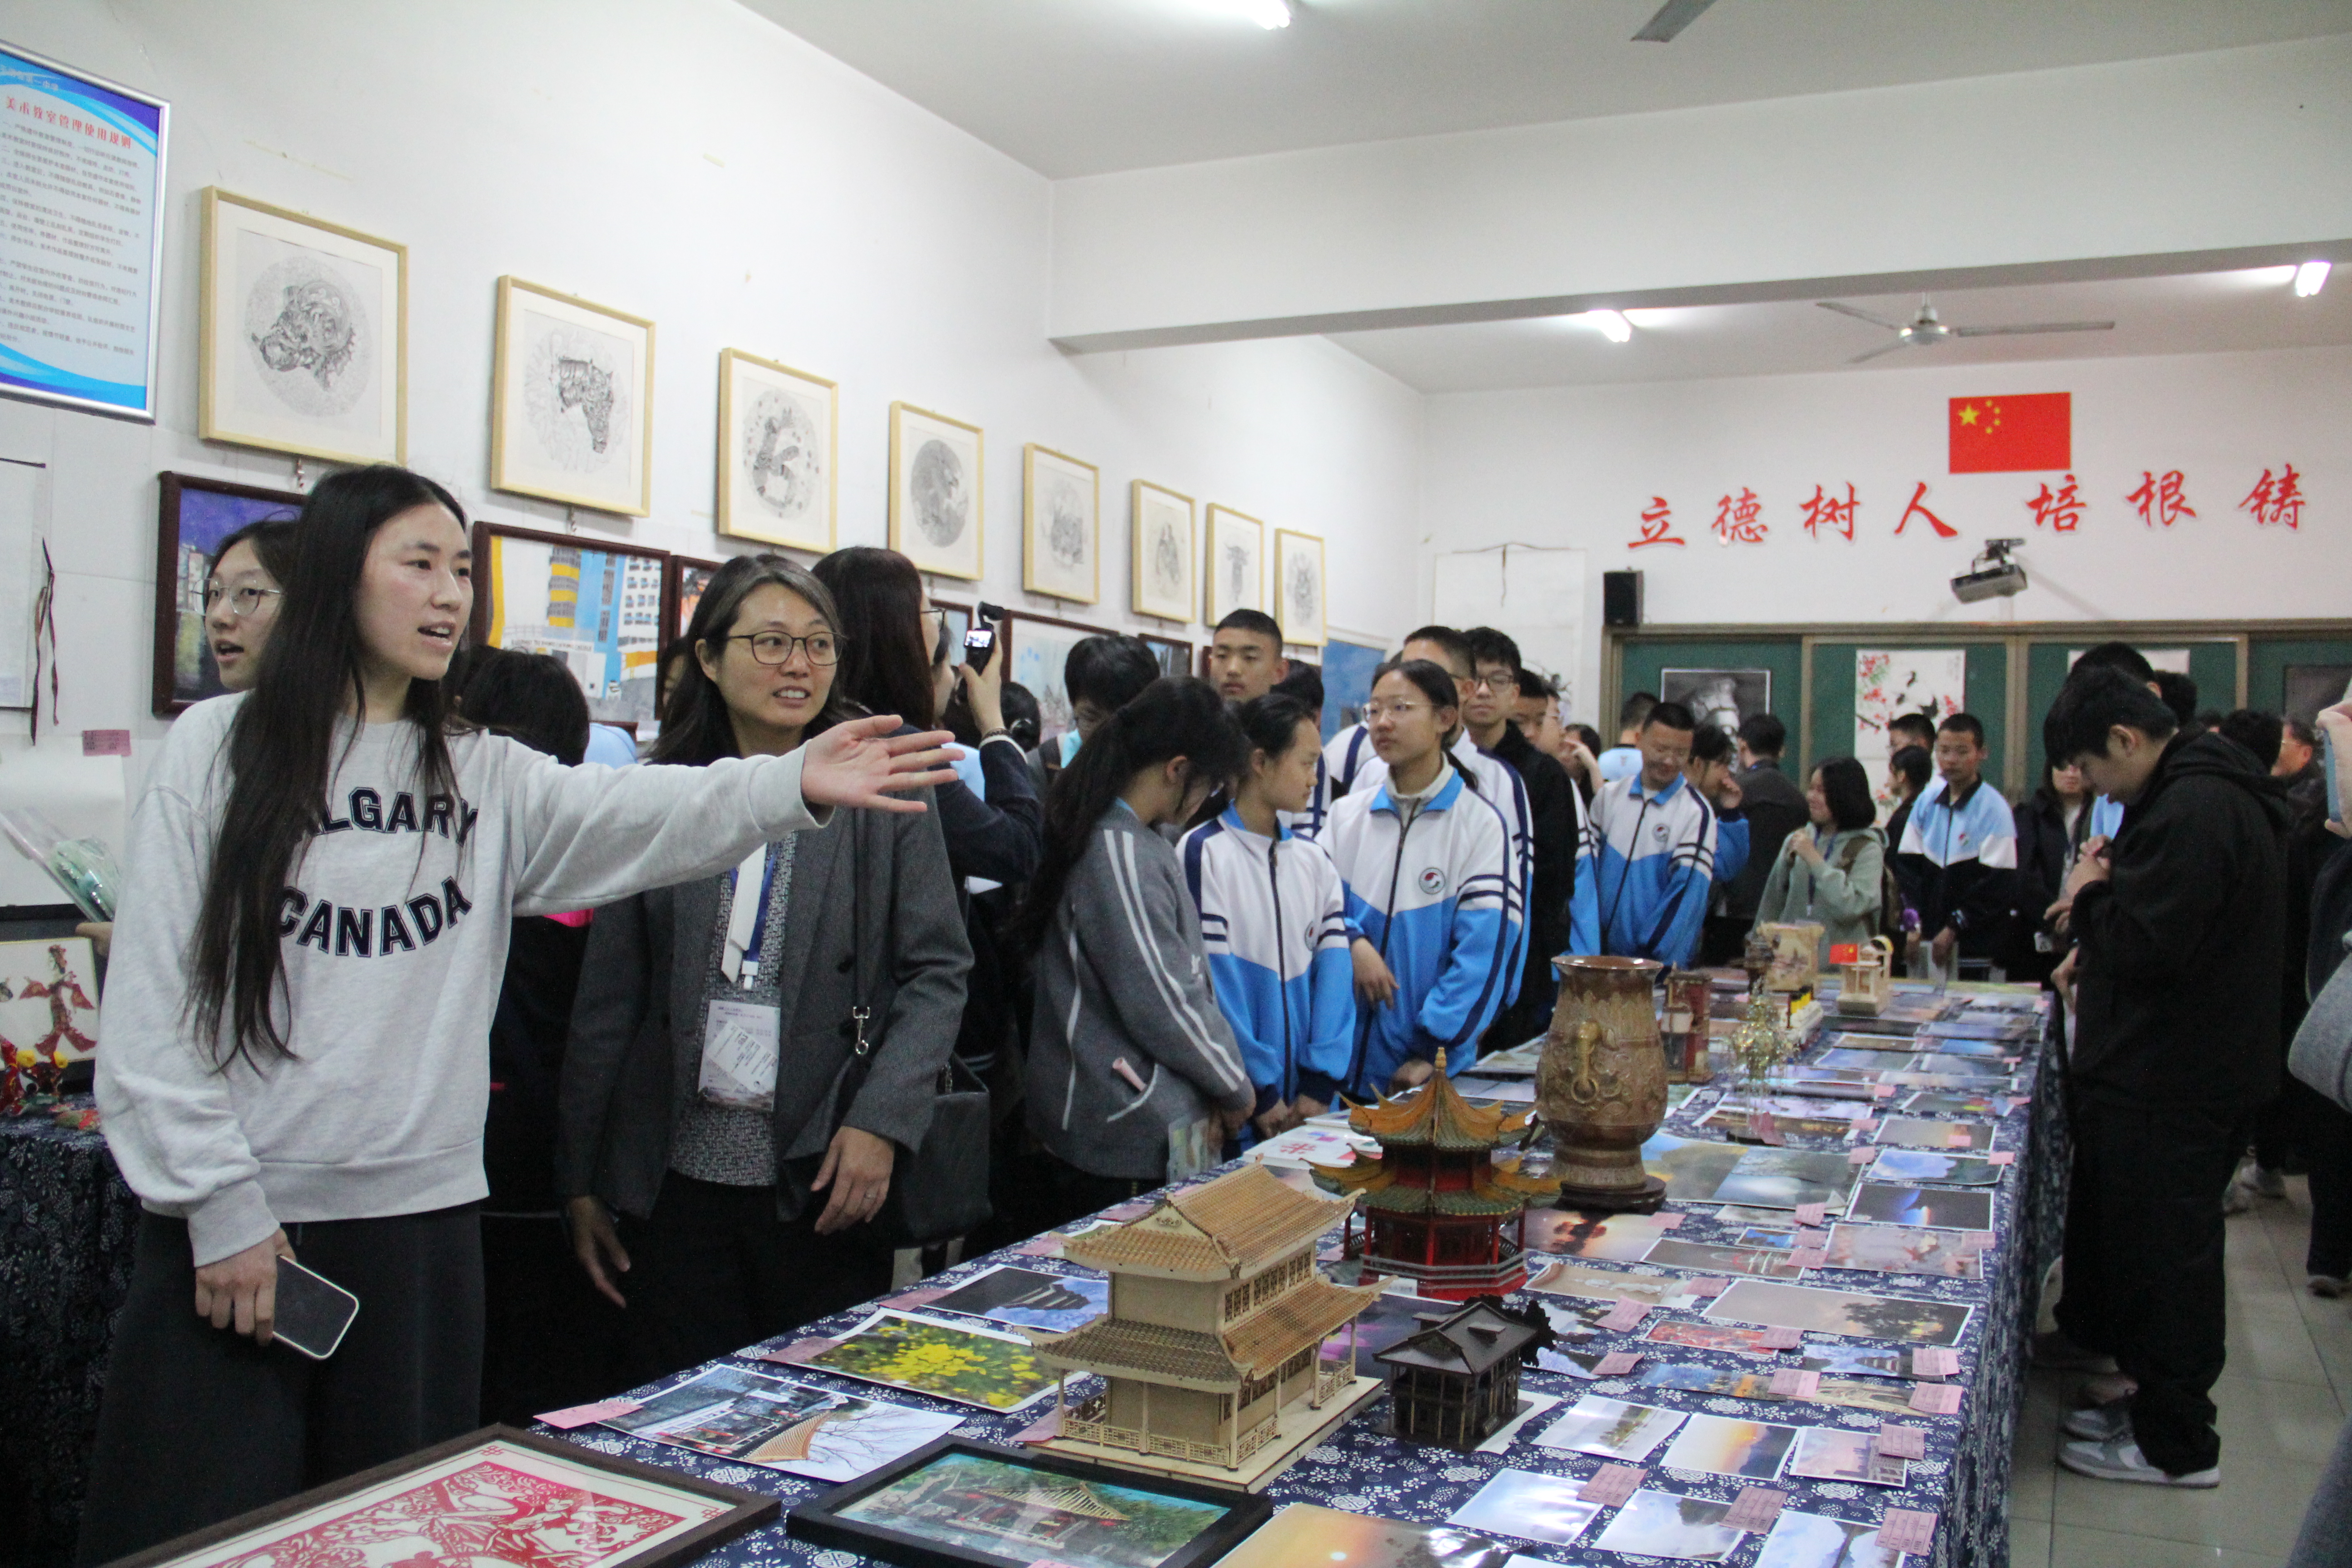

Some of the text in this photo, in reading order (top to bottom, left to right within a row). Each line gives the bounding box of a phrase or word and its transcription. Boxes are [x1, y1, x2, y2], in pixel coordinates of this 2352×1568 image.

[1627, 463, 2305, 549] 立德树人 培根铸
[314, 787, 478, 846] LGARY
[279, 876, 472, 957] CANADA
